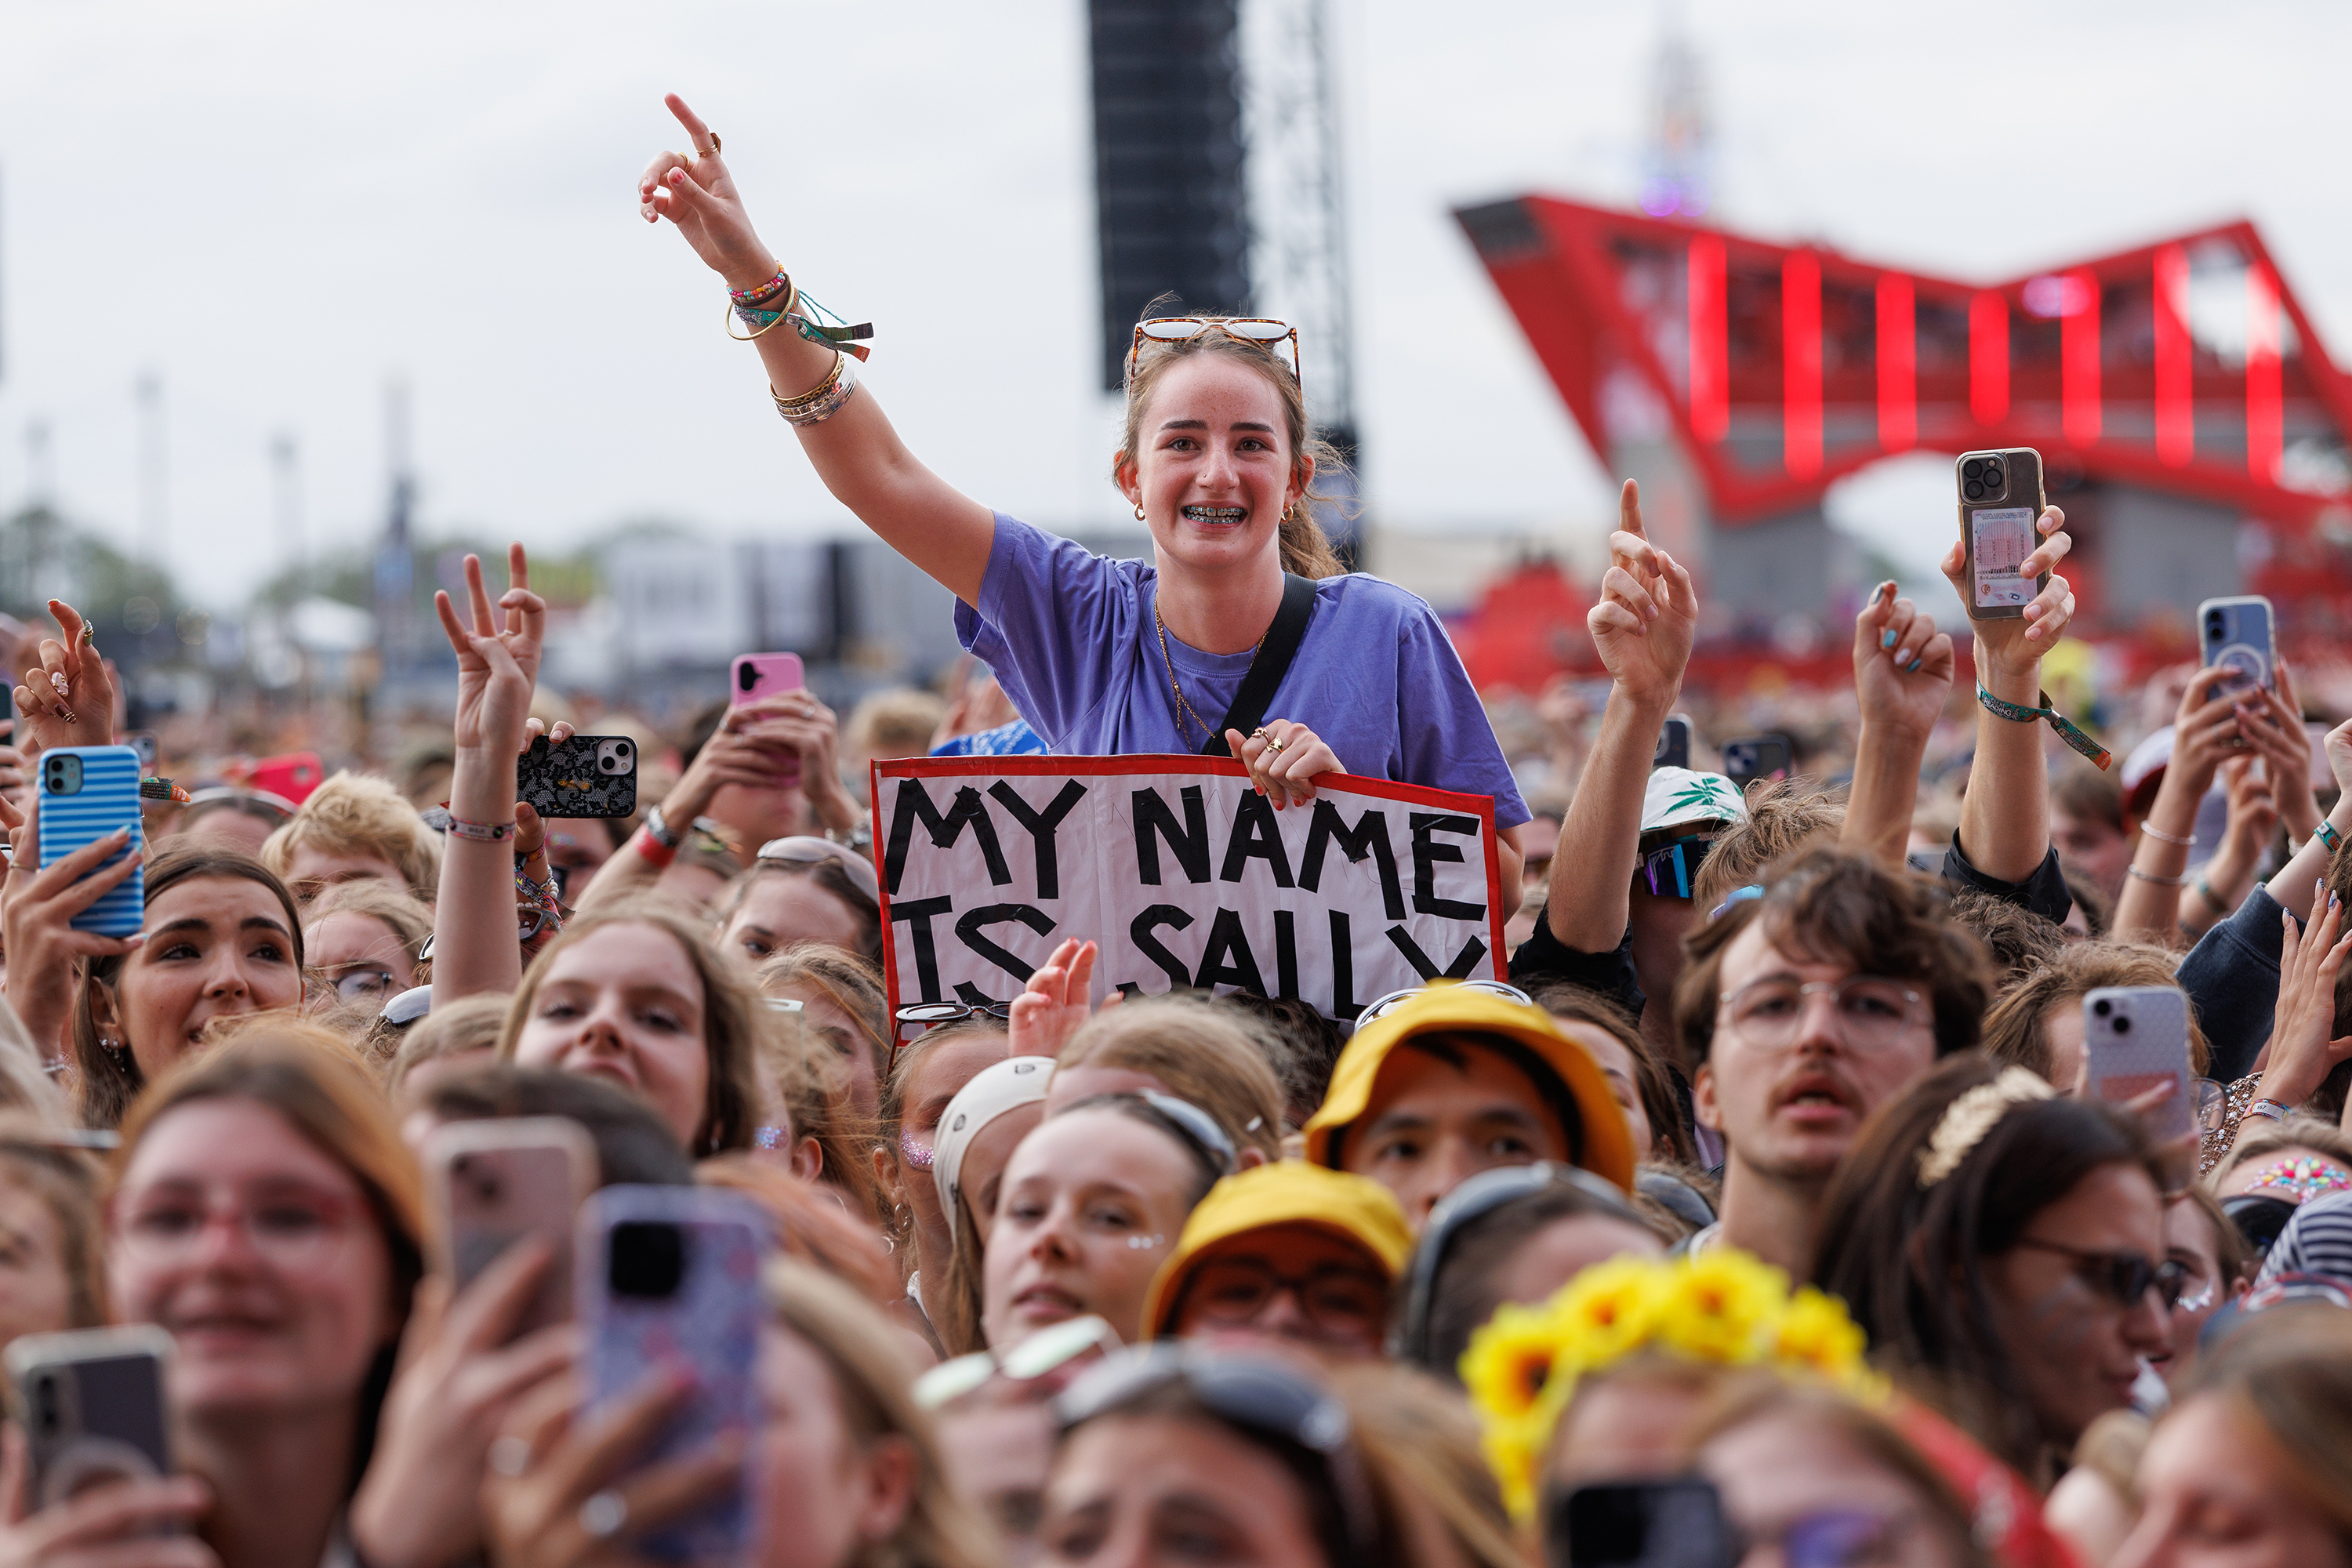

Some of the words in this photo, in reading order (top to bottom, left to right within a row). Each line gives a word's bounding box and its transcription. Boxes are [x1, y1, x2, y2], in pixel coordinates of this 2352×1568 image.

[1984, 696, 2013, 717] READING
[882, 777, 1088, 900] MY
[1131, 784, 1487, 922] NAME
[889, 895, 1058, 1010] IS
[1115, 903, 1488, 1021] SALLY
